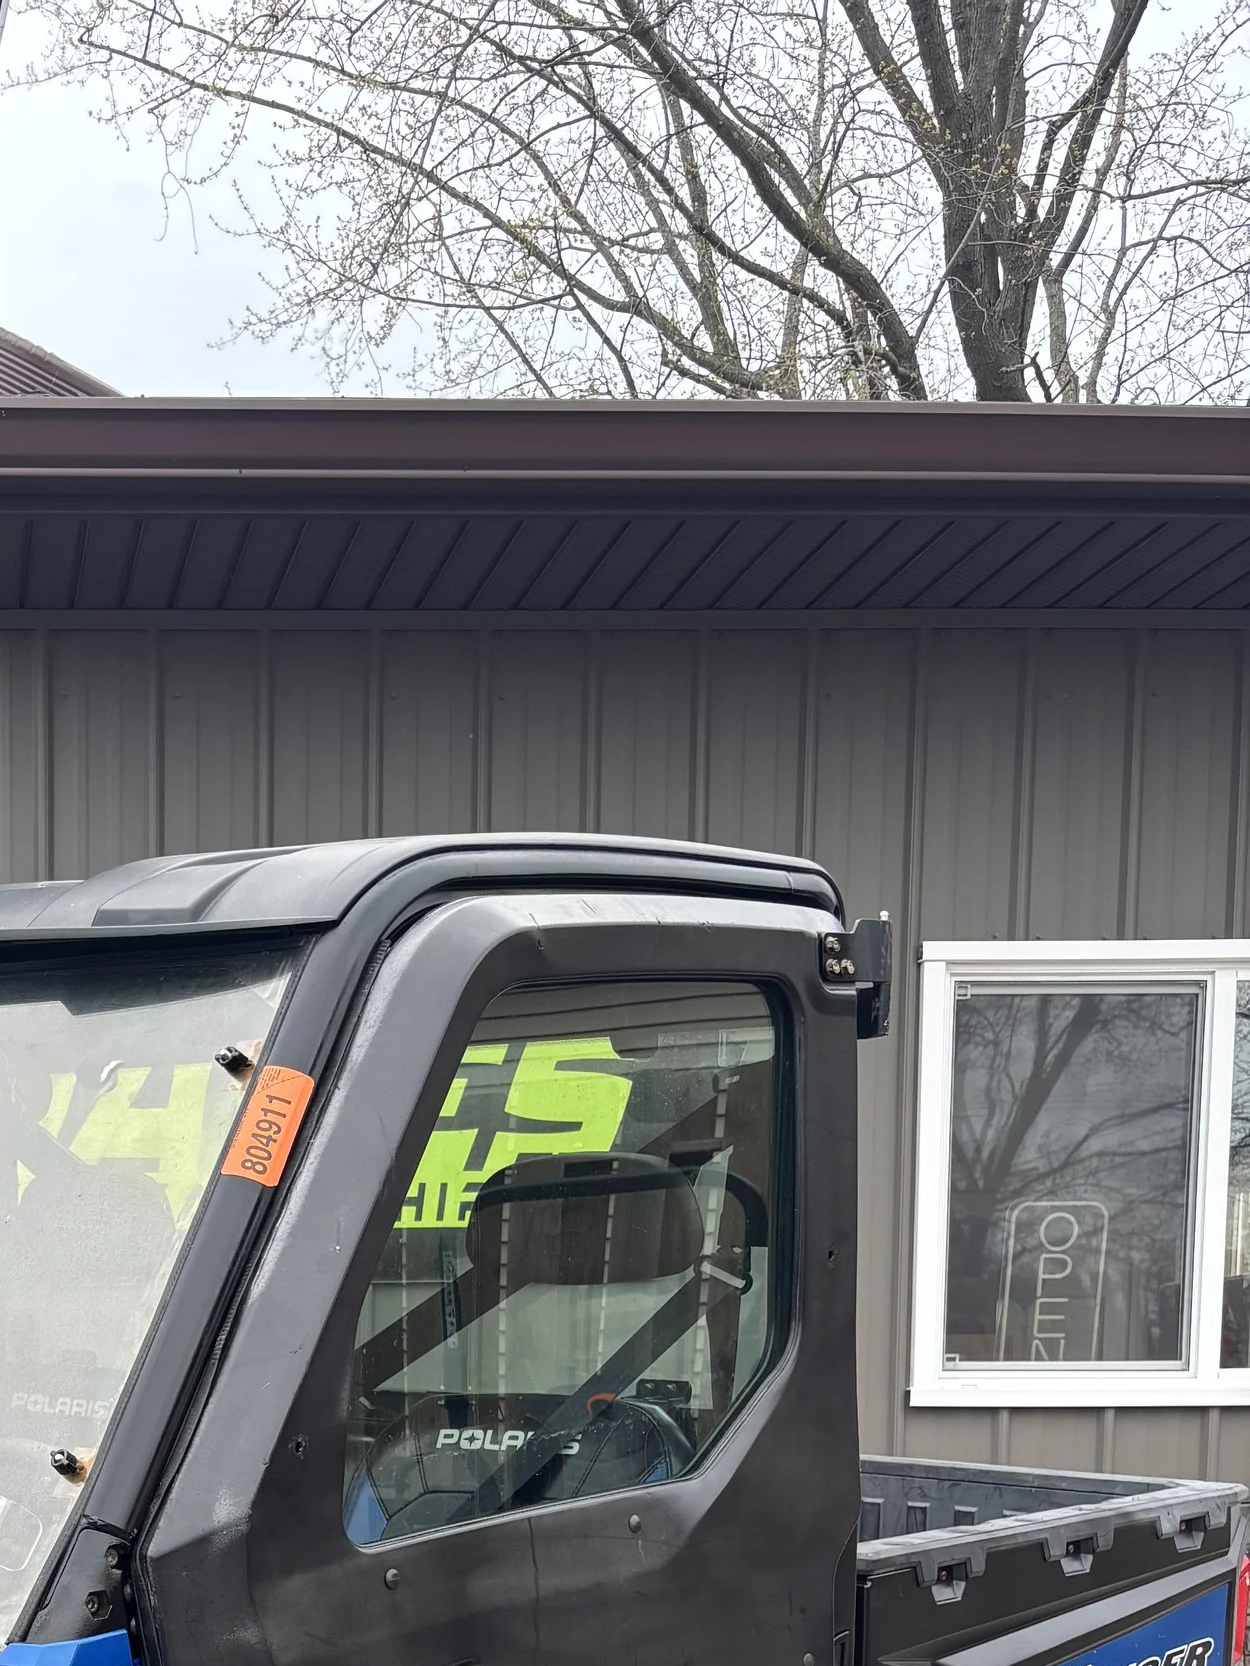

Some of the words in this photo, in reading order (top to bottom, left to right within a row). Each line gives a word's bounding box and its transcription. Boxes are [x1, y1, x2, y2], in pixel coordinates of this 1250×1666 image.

[240, 1094, 292, 1175] 804911
[1030, 1212, 1079, 1361] OPEN
[11, 1392, 110, 1419] POLARIS
[435, 1428, 583, 1456] POLAS
